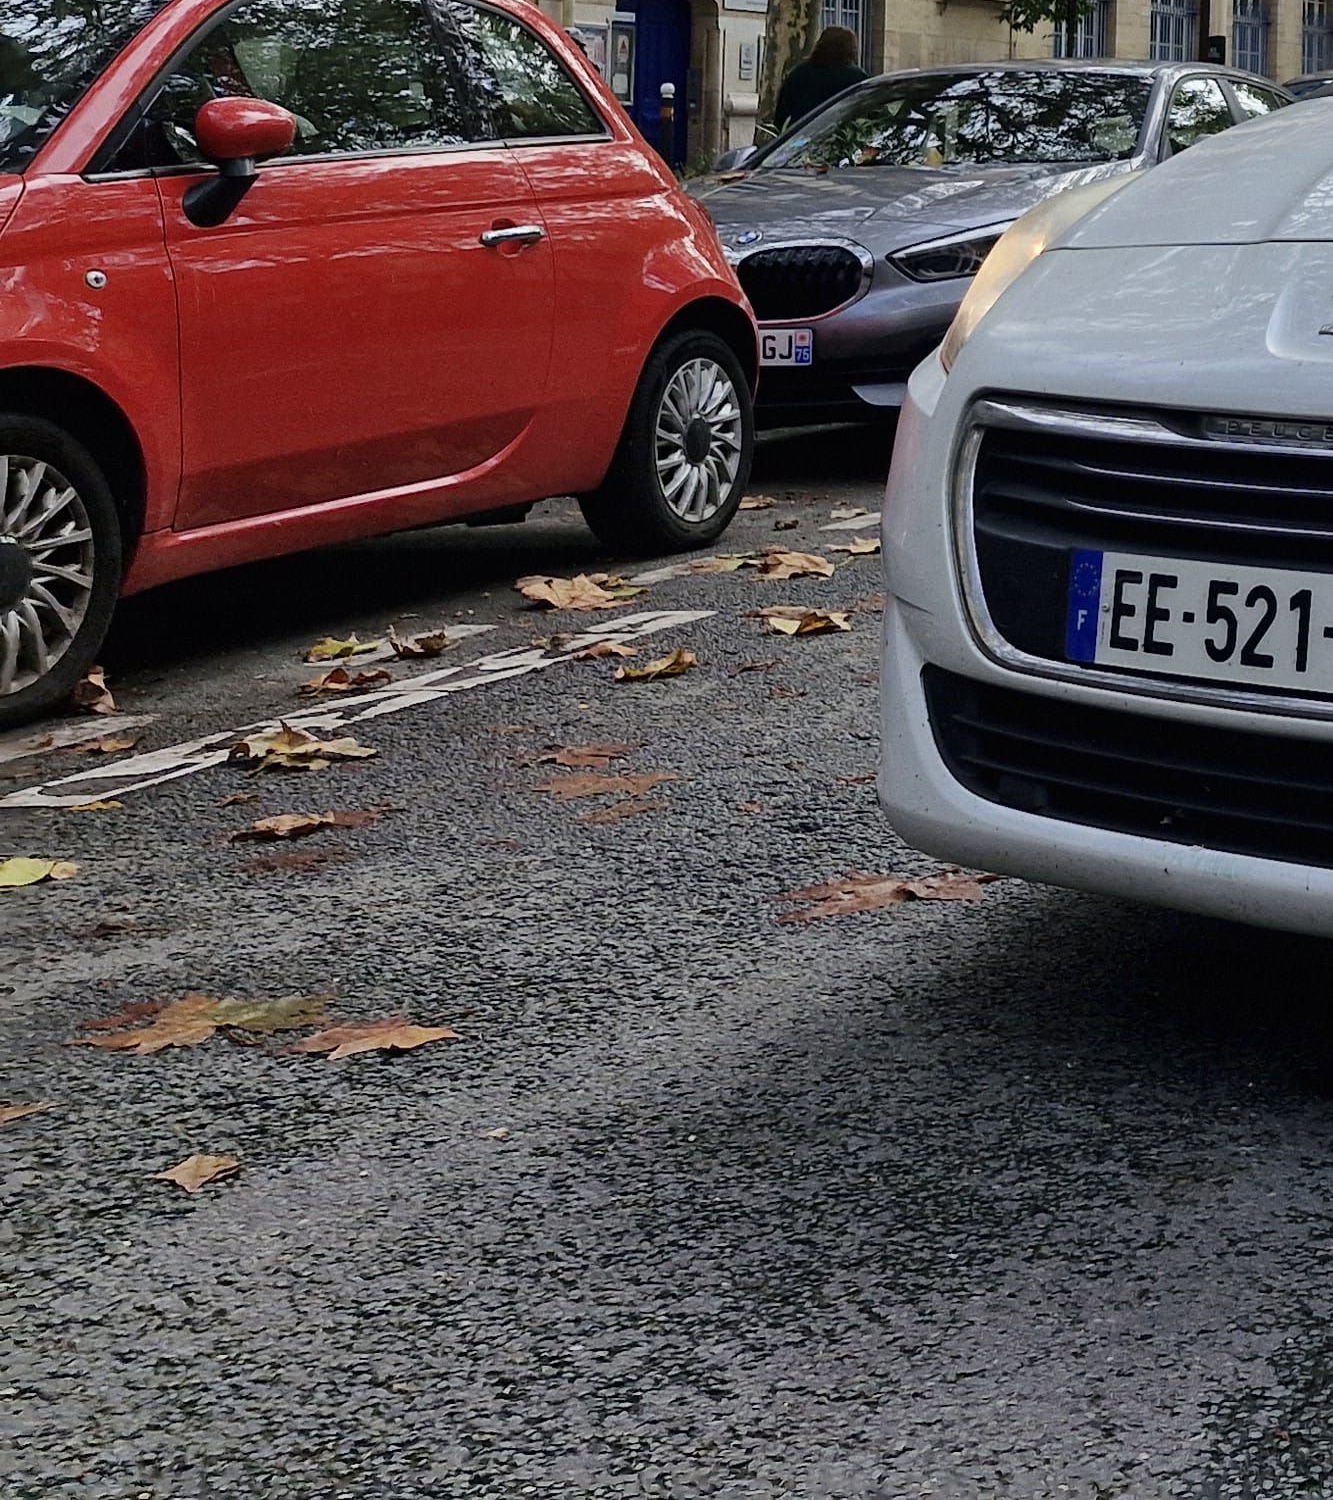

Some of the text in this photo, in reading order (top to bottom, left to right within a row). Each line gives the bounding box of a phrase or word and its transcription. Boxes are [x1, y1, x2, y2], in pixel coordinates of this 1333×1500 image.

[762, 335, 810, 361] GJ 75
[1077, 610, 1087, 631] F
